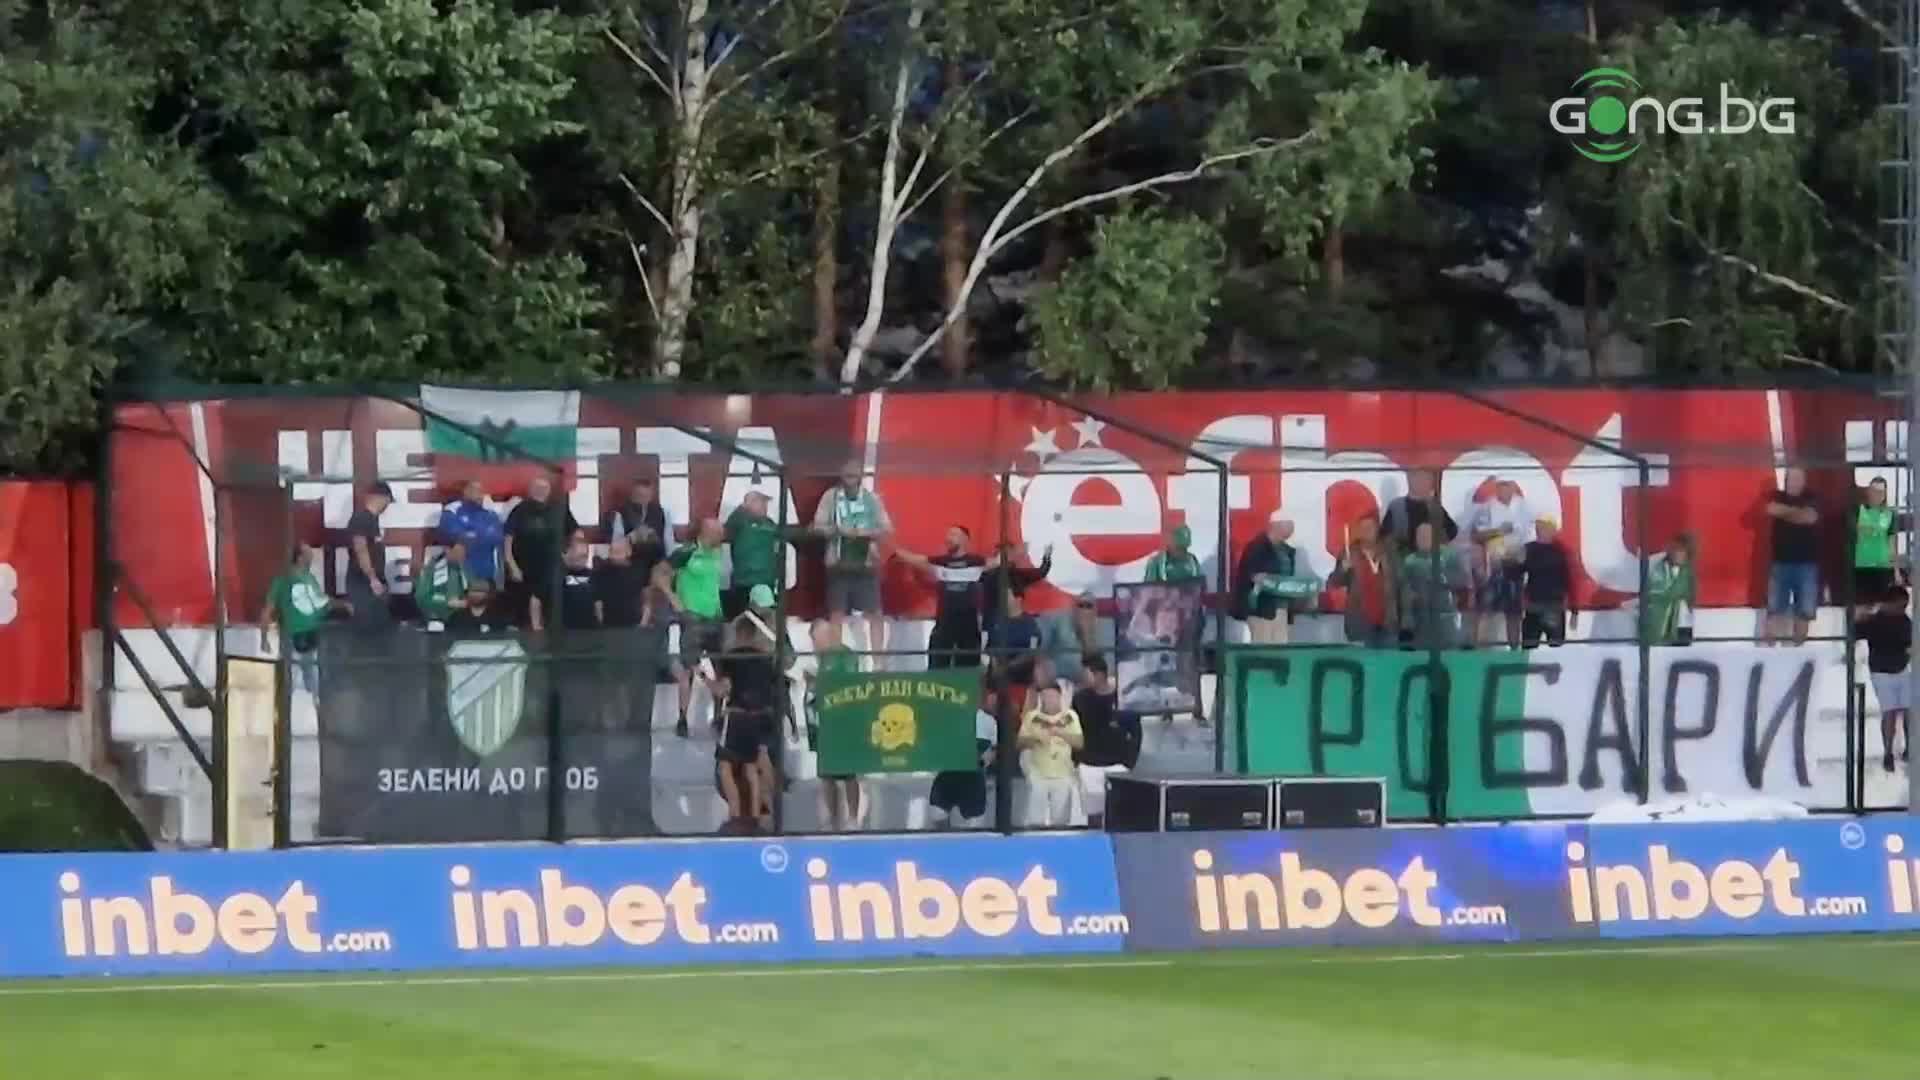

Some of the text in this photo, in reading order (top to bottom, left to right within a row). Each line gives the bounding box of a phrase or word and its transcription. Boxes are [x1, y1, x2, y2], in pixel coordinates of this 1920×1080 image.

[1234, 656, 1812, 795] ГРОБАРИ
[377, 766, 599, 795] ЗЕЛЕНИ ДО ГОБ
[59, 871, 391, 957] inbet.com
[449, 865, 779, 950] inbet.com
[806, 858, 1129, 942] inbet.com
[1193, 850, 1507, 932] inbet.com
[1567, 841, 1867, 922] inbet.com
